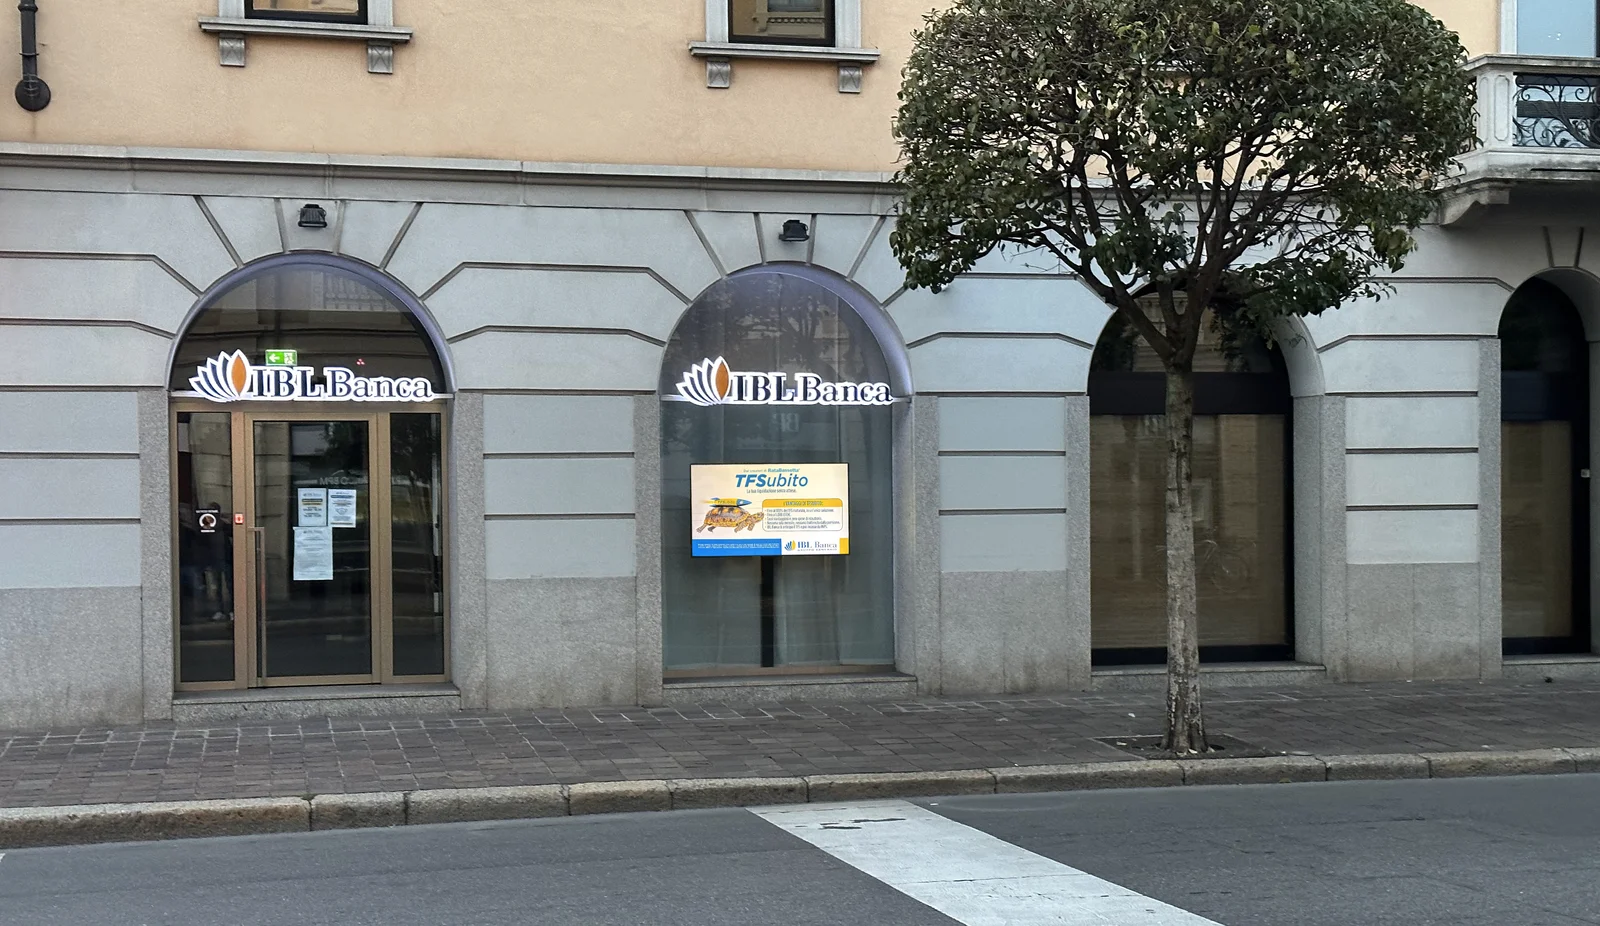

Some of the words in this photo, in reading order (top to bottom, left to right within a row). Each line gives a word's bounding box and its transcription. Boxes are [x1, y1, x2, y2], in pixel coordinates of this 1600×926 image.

[250, 367, 322, 399] IBL
[326, 368, 432, 399] Banca
[732, 373, 796, 403] IBL
[798, 374, 894, 403] Banca
[735, 473, 809, 488] TFSubito
[797, 541, 813, 549] IBL
[814, 541, 838, 549] Banca
